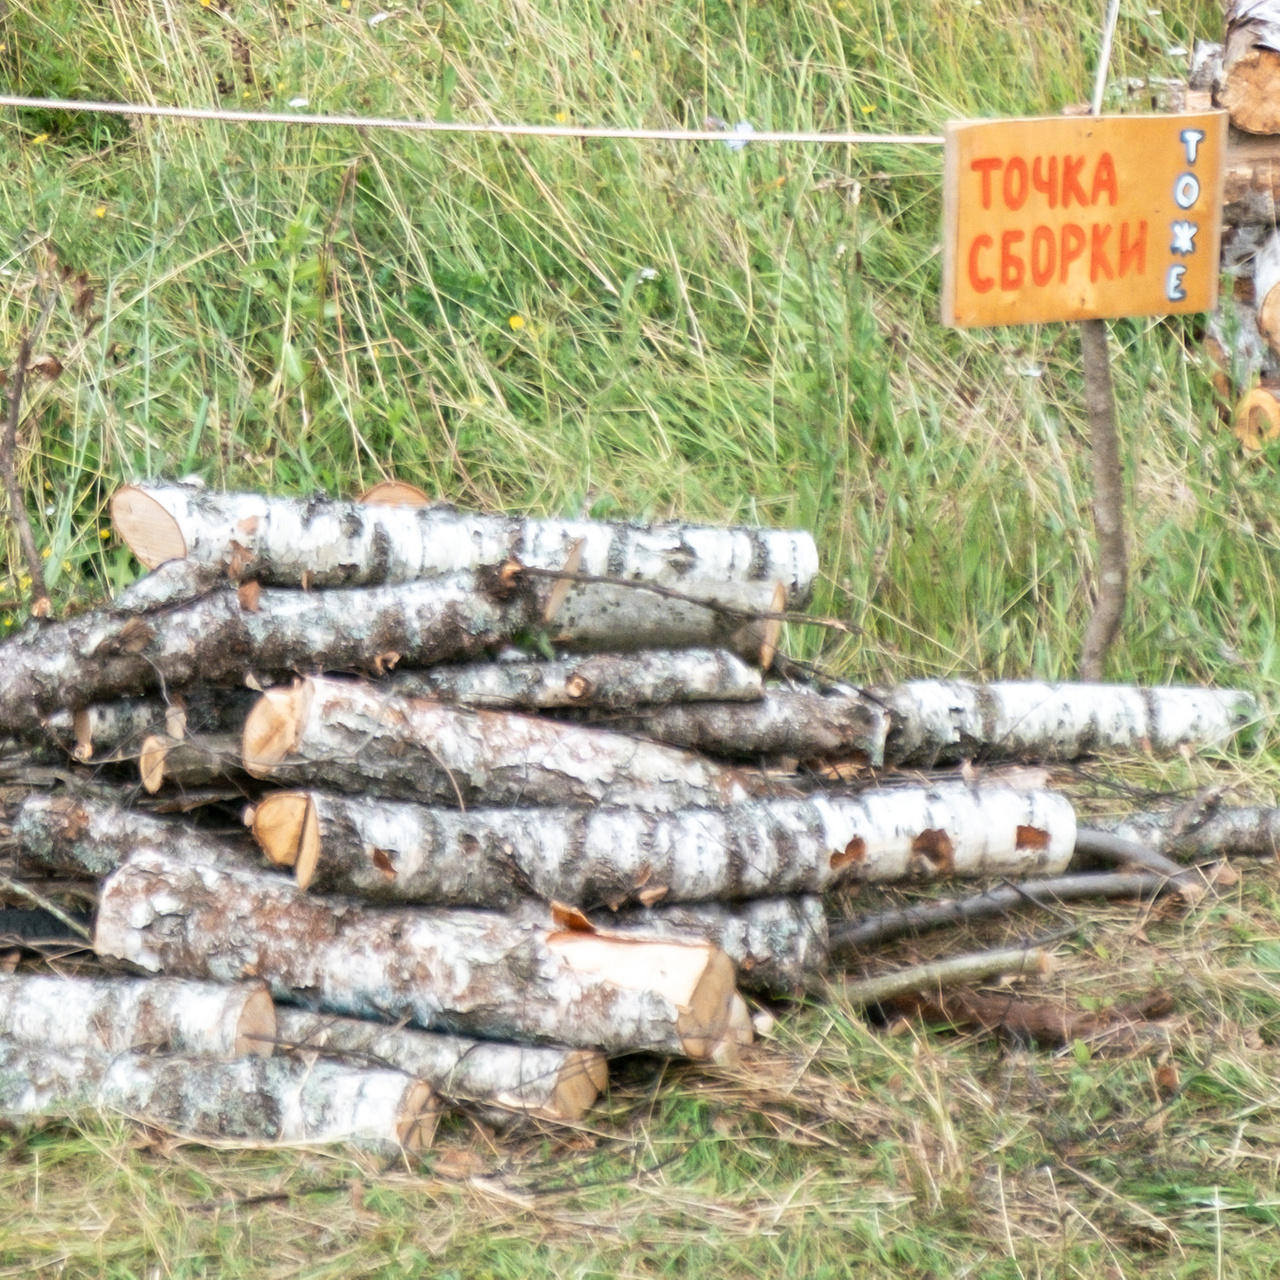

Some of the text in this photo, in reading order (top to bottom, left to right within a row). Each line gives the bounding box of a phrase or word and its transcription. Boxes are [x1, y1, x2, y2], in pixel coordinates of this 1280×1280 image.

[970, 151, 1119, 211] ТОЧКА
[1166, 128, 1206, 302] ТОЖЕ
[967, 220, 1149, 294] СБОРКИ
